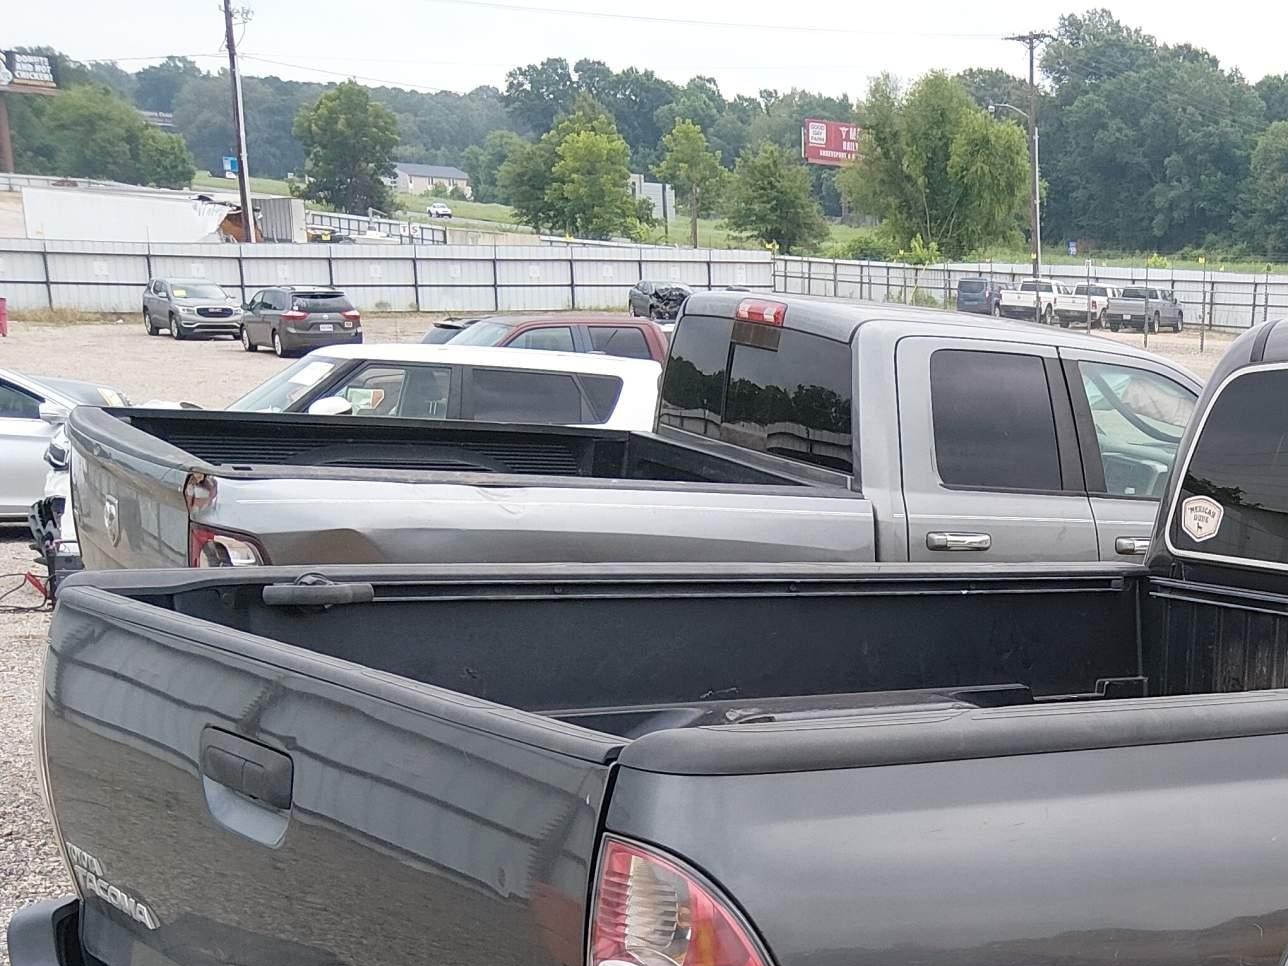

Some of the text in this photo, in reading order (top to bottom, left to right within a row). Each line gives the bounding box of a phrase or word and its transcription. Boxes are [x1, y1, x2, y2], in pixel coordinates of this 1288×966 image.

[15, 62, 52, 74] AND HOT
[74, 864, 157, 930] TACOMA
